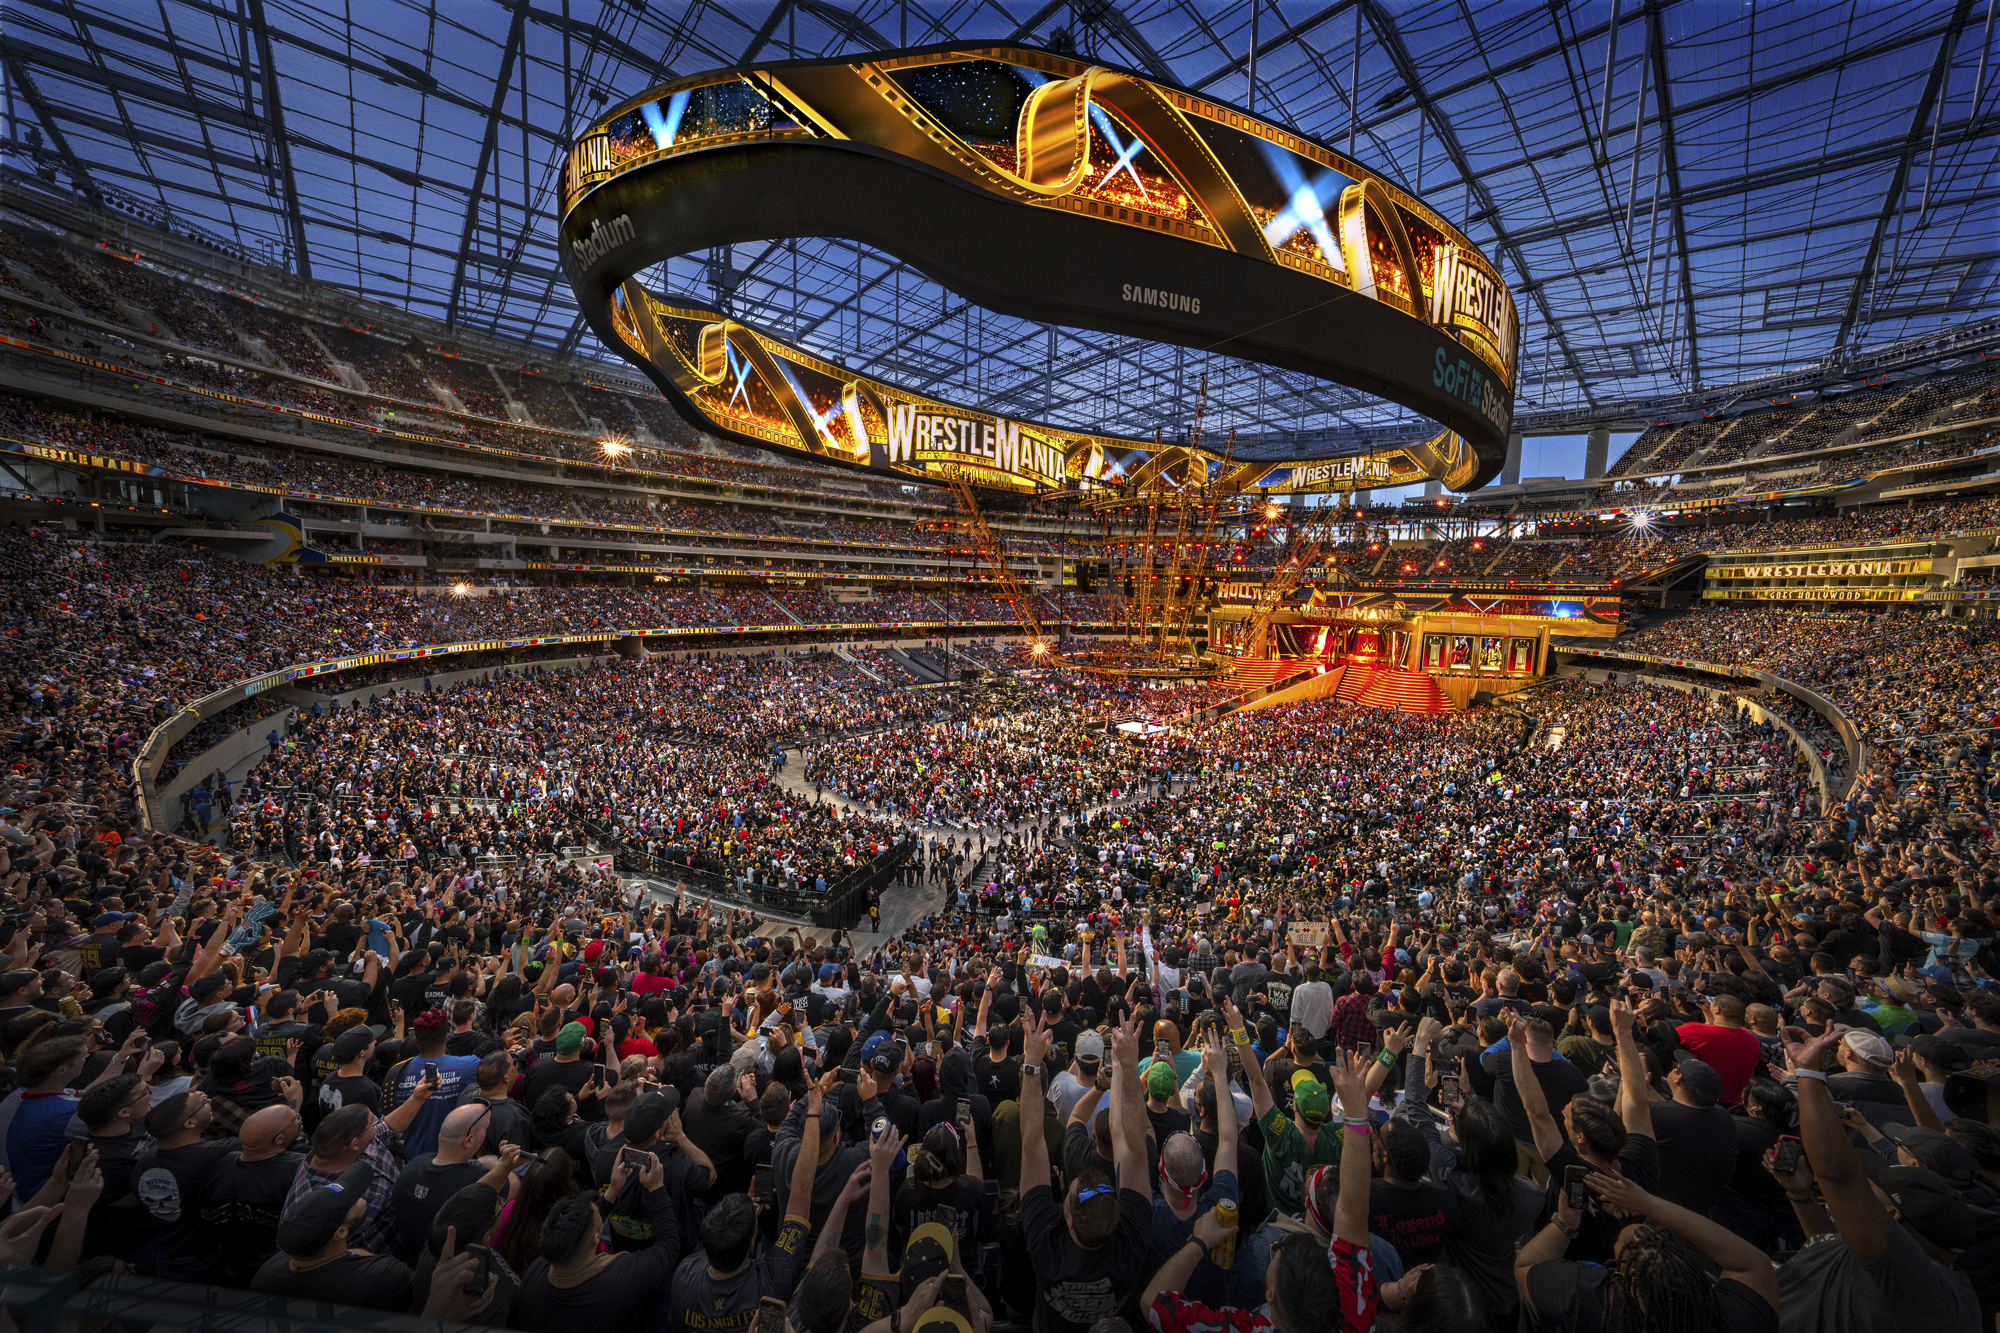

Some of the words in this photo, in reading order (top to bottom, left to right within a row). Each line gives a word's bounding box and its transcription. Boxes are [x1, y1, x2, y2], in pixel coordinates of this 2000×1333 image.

[572, 214, 637, 272] Stadium
[1121, 282, 1201, 315] SAMSUNG
[1432, 346, 1470, 402] SoFi
[886, 403, 1067, 484] WRESTLEMANIA
[1291, 456, 1391, 490] WRESTLEMANIA
[1743, 561, 1893, 579] WRESTLEMANIA
[1769, 591, 1793, 600] GOES
[1796, 590, 1861, 600] HOLLYWOOD
[1301, 603, 1403, 622] WRESTLEMANIA
[1268, 996, 1289, 1007] THERE
[1273, 990, 1290, 1000] WAS
[539, 1051, 555, 1060] FIGHT
[398, 1081, 417, 1089] CEN
[146, 1178, 171, 1187] STONE
[1374, 1208, 1446, 1234] Legend
[1387, 1232, 1442, 1251] Killer
[684, 1308, 706, 1329] LOS
